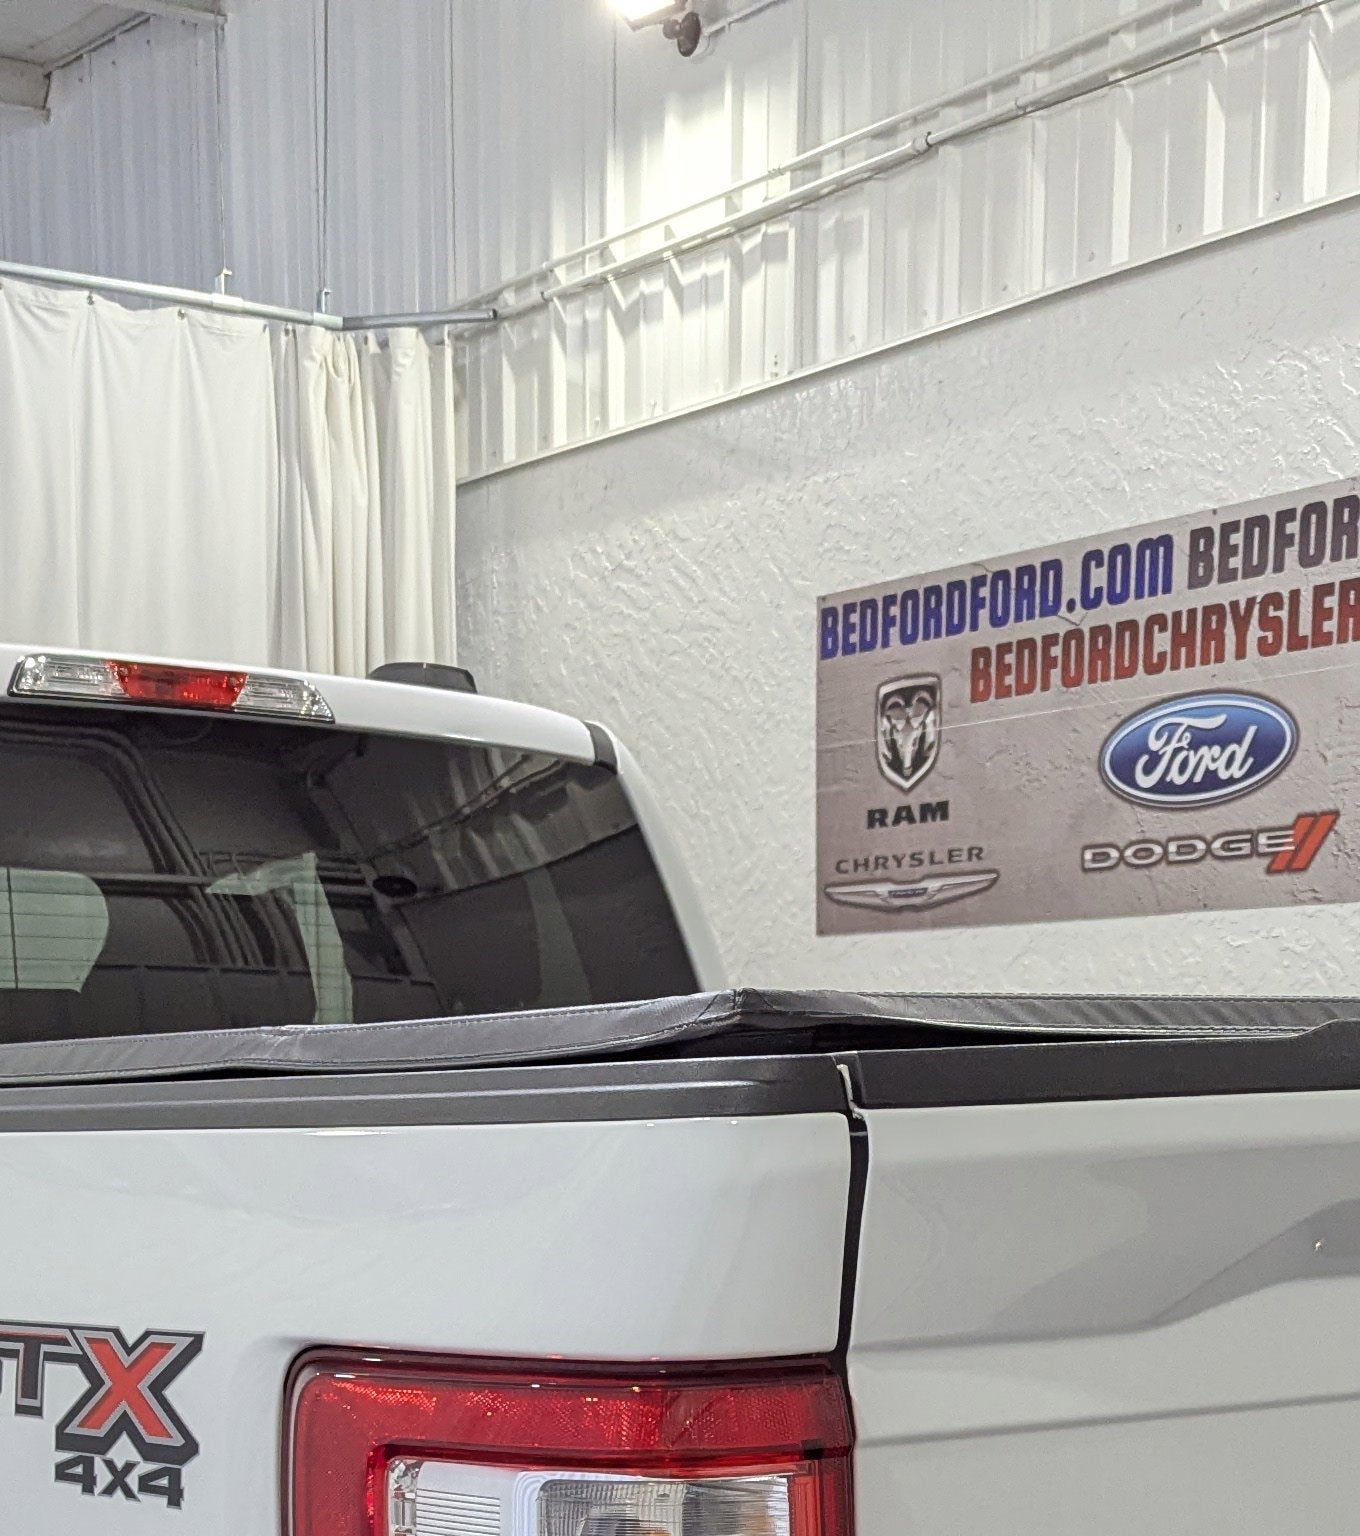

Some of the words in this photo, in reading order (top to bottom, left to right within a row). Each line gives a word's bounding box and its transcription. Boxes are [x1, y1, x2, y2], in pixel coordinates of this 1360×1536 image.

[820, 534, 1174, 661] BEDFORDFORD.COM
[1134, 714, 1256, 789] Ford
[866, 800, 950, 830] RAM
[835, 846, 984, 874] CHRYSLER
[1081, 829, 1297, 874] DODGE
